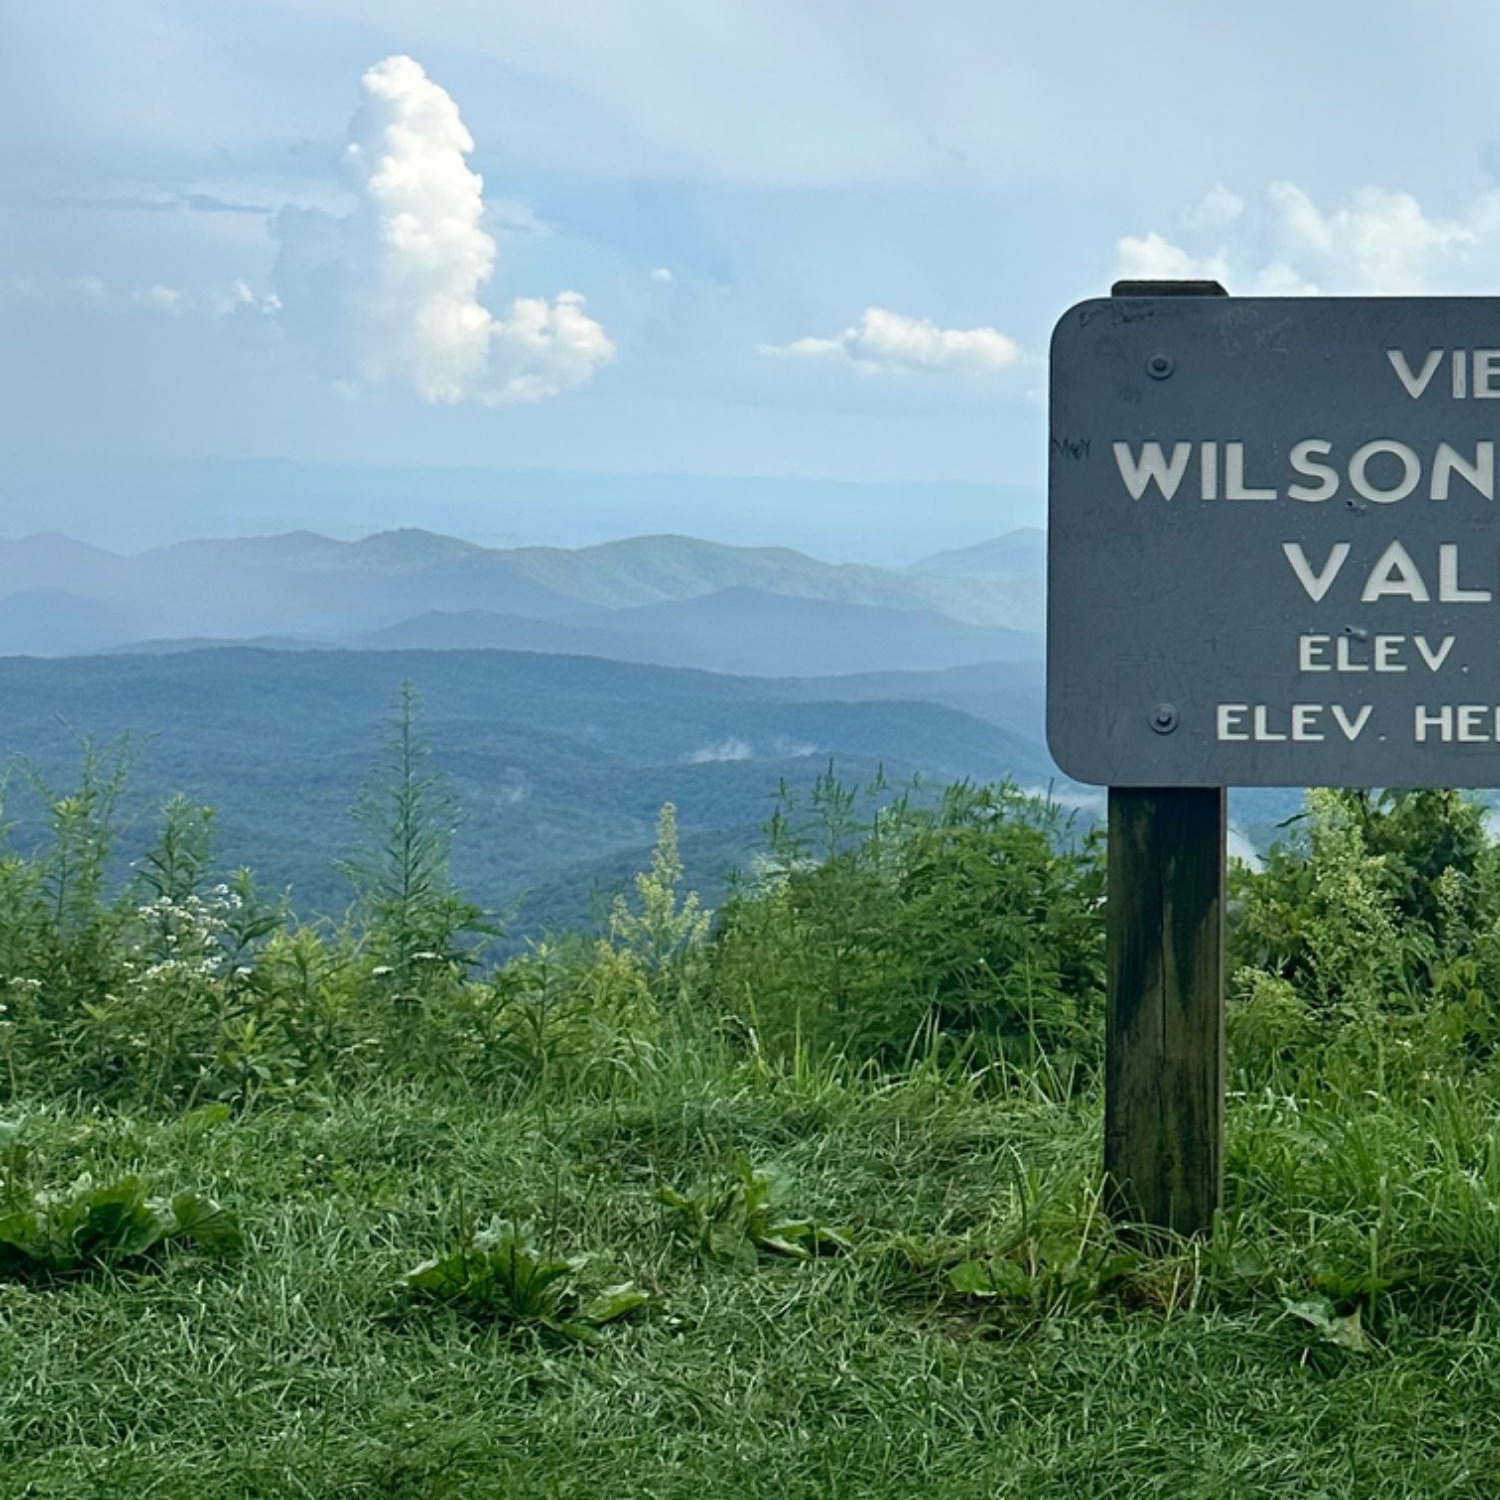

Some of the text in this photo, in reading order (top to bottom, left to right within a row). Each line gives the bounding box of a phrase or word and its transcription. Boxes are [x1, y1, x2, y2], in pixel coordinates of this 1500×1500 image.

[1112, 438, 1495, 504] WILSON
[1299, 635, 1469, 673] ELEV.
[1216, 704, 1387, 742] ELEV.
